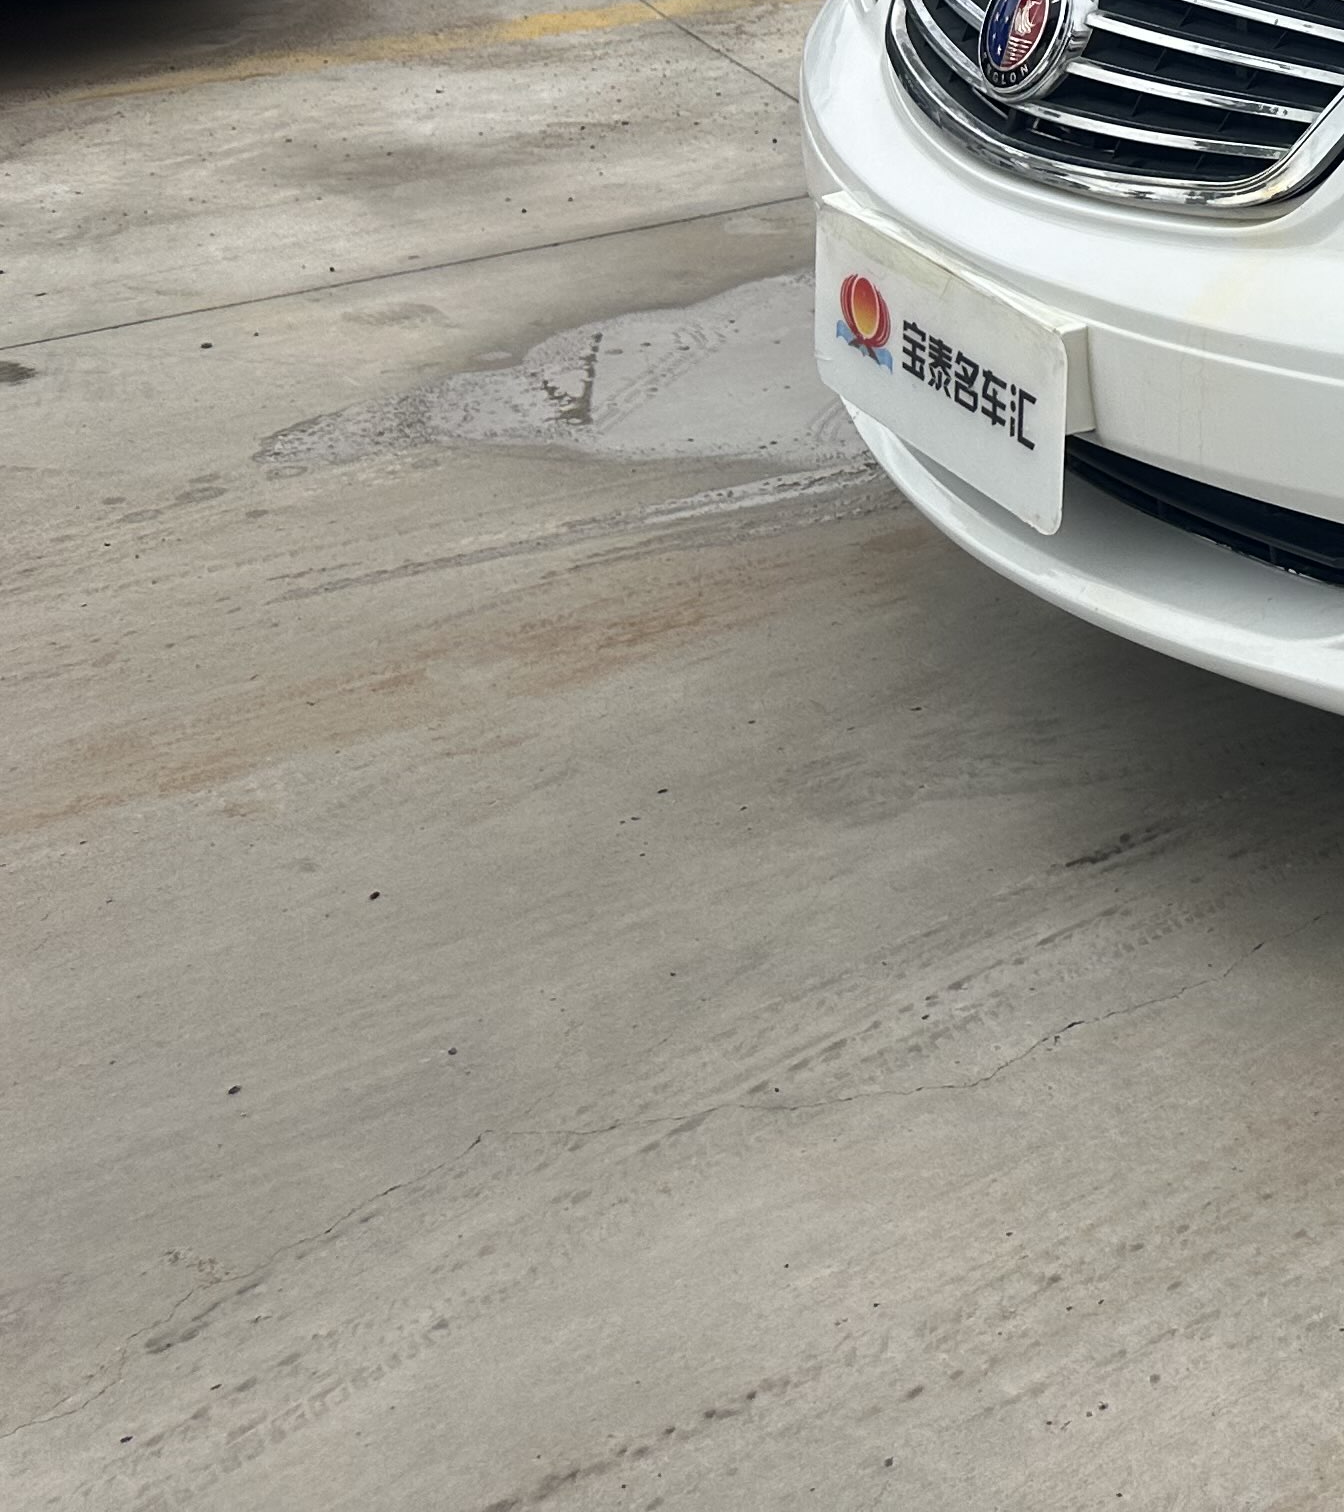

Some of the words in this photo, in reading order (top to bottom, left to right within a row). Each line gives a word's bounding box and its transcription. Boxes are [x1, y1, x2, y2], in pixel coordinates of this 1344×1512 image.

[902, 319, 1037, 451] 宝泰名车汇
